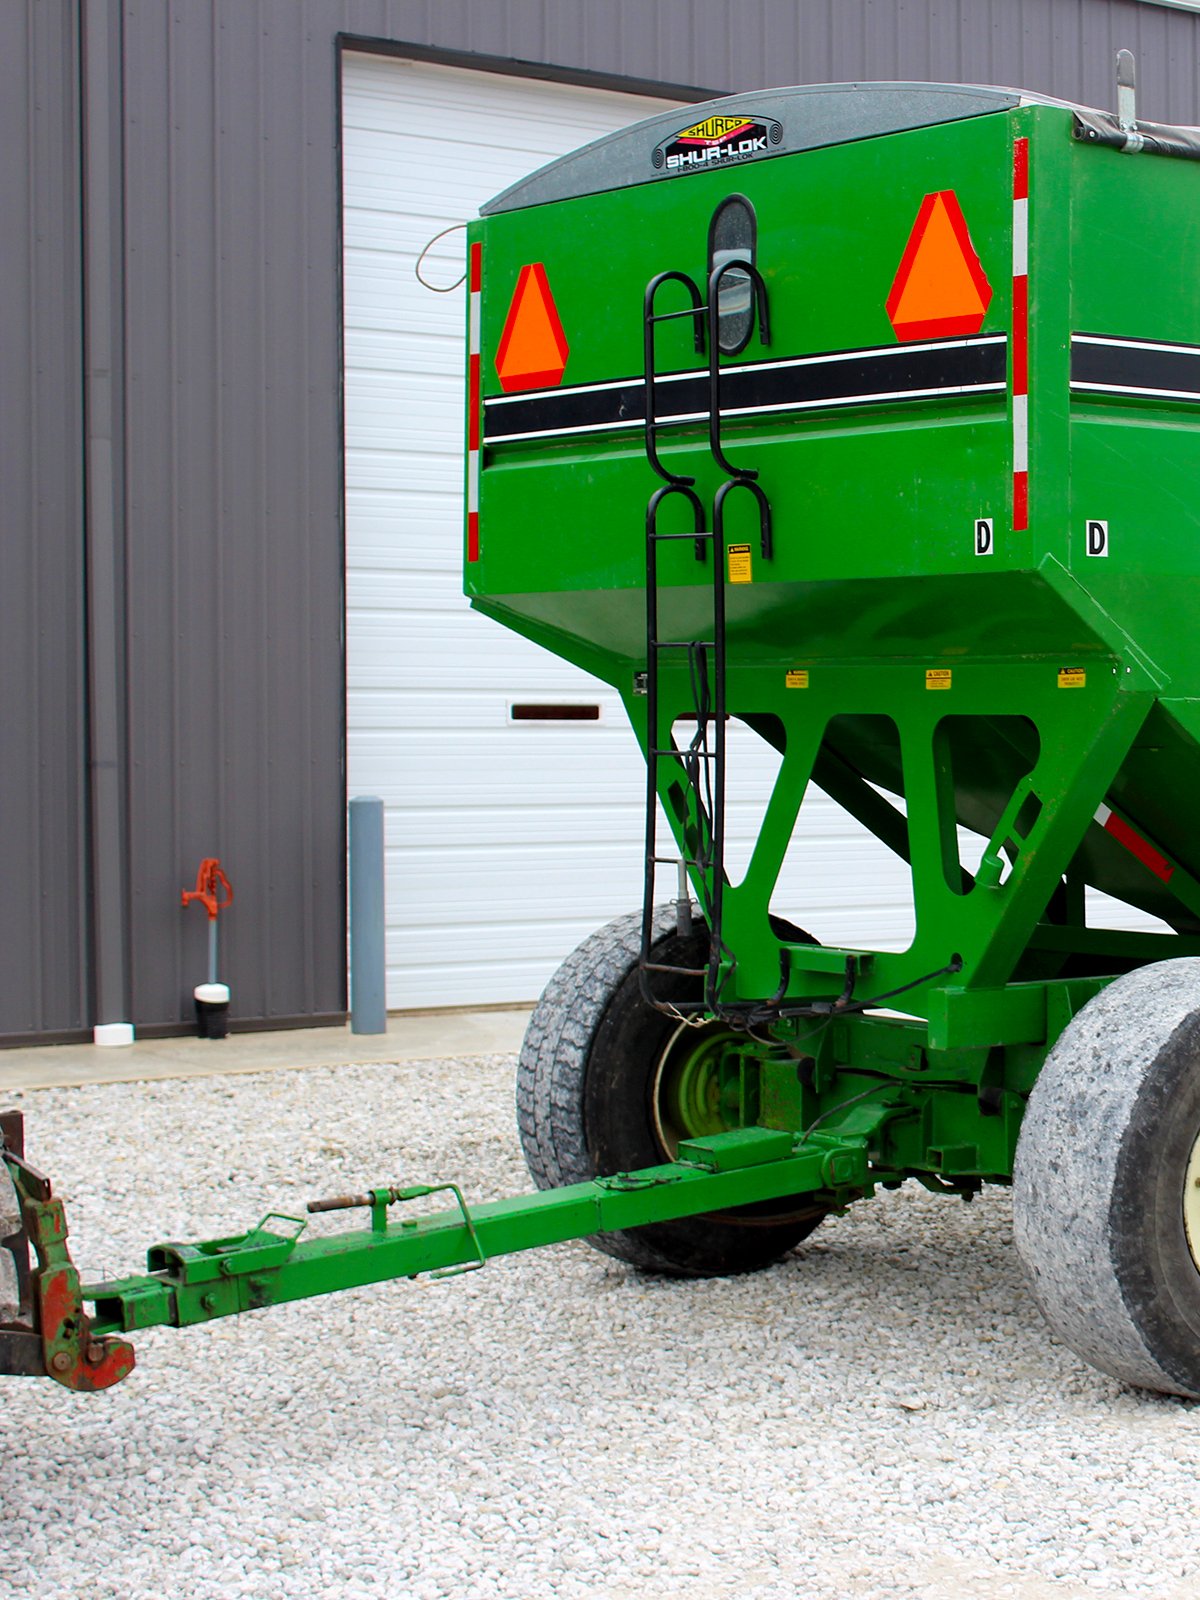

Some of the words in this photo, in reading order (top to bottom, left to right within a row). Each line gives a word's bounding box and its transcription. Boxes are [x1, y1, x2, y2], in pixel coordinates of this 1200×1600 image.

[687, 118, 743, 137] SHURCO
[666, 136, 768, 170] SHUR-LOK
[977, 520, 991, 554] D
[1088, 522, 1106, 555] D
